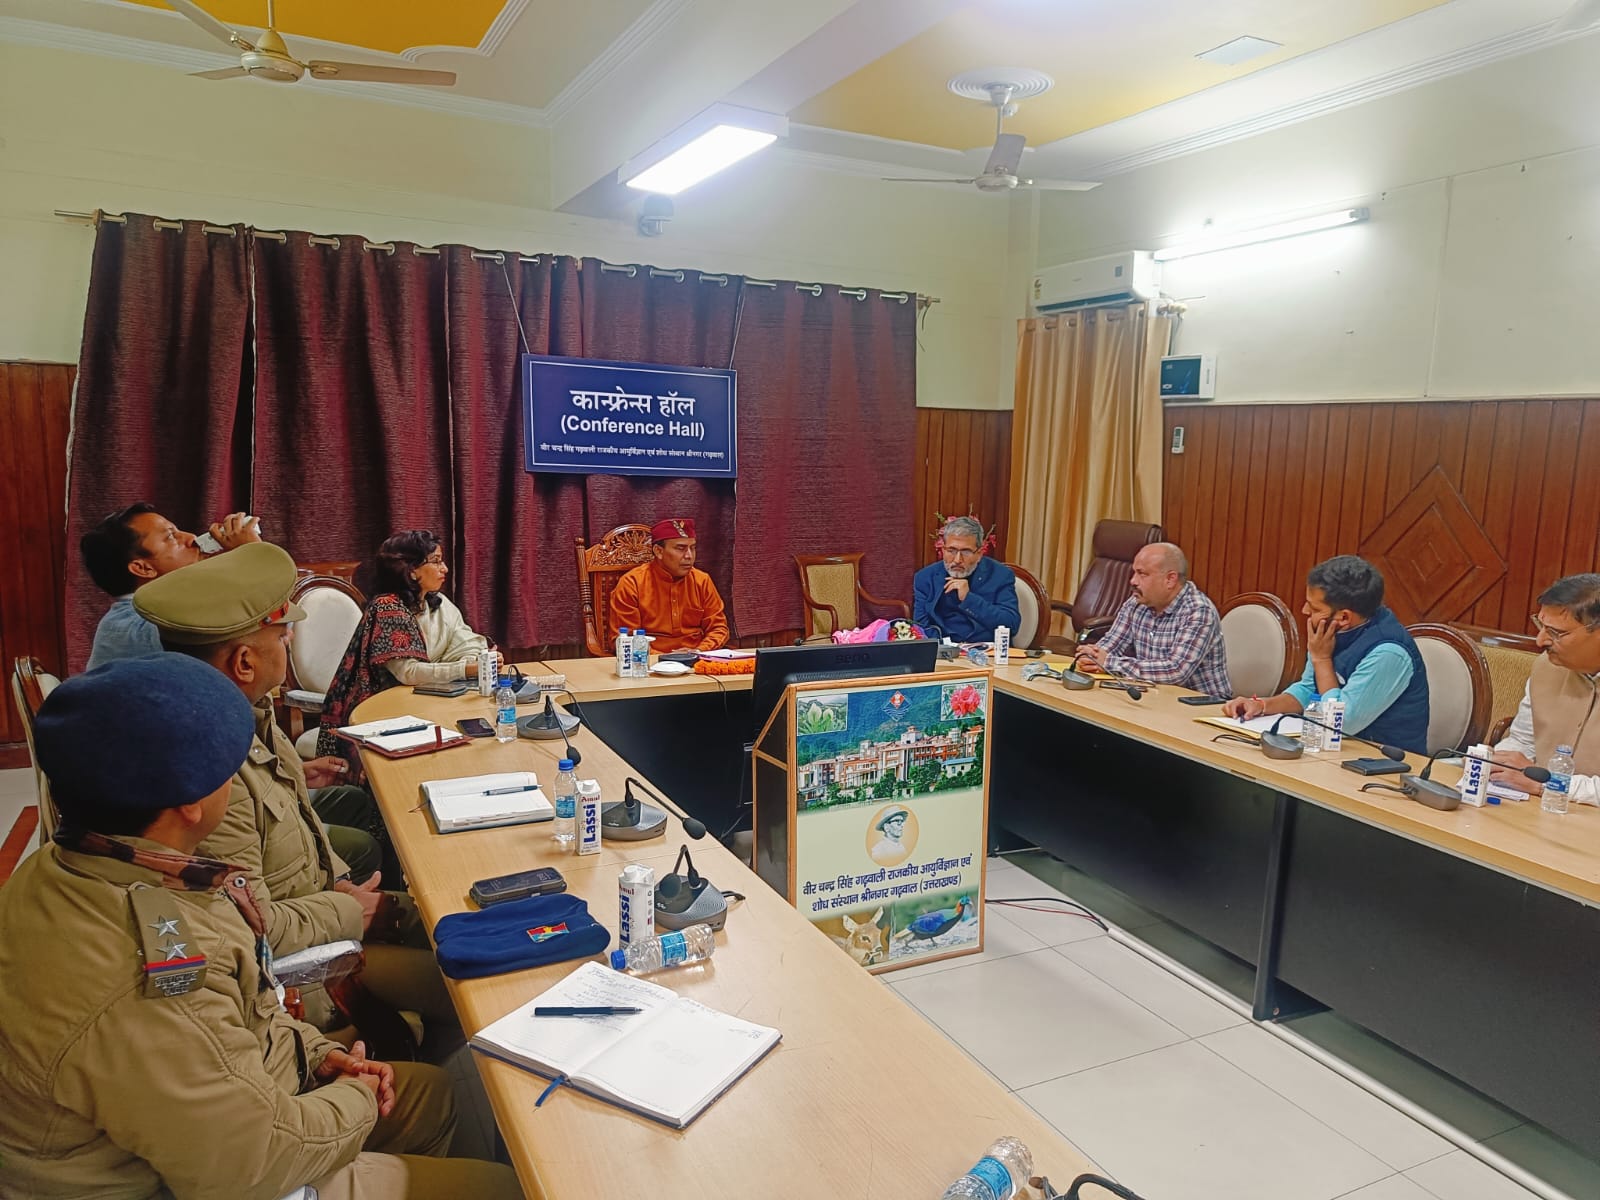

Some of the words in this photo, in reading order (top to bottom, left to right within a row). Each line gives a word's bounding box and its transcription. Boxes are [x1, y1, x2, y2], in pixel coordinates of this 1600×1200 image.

[569, 386, 653, 413] कान्फ्रेन्स
[657, 391, 696, 417] हॉल
[561, 415, 664, 435] (Conference
[669, 421, 705, 440] Hall)
[1465, 759, 1482, 795] Lassi
[583, 803, 596, 843] Lassi
[803, 881, 817, 895] वीर
[818, 881, 835, 892] चन्द्र
[837, 875, 853, 889] सिंह
[887, 863, 919, 880] राजकीय
[920, 857, 959, 877] आयुर्विज्ञान
[960, 853, 973, 867] एवं
[812, 898, 830, 912] शोध
[831, 894, 859, 908] संस्थान
[860, 888, 889, 902] श्रीनगर
[920, 871, 962, 893] (उत्तराखण्ड)
[619, 894, 630, 943] Lassi
